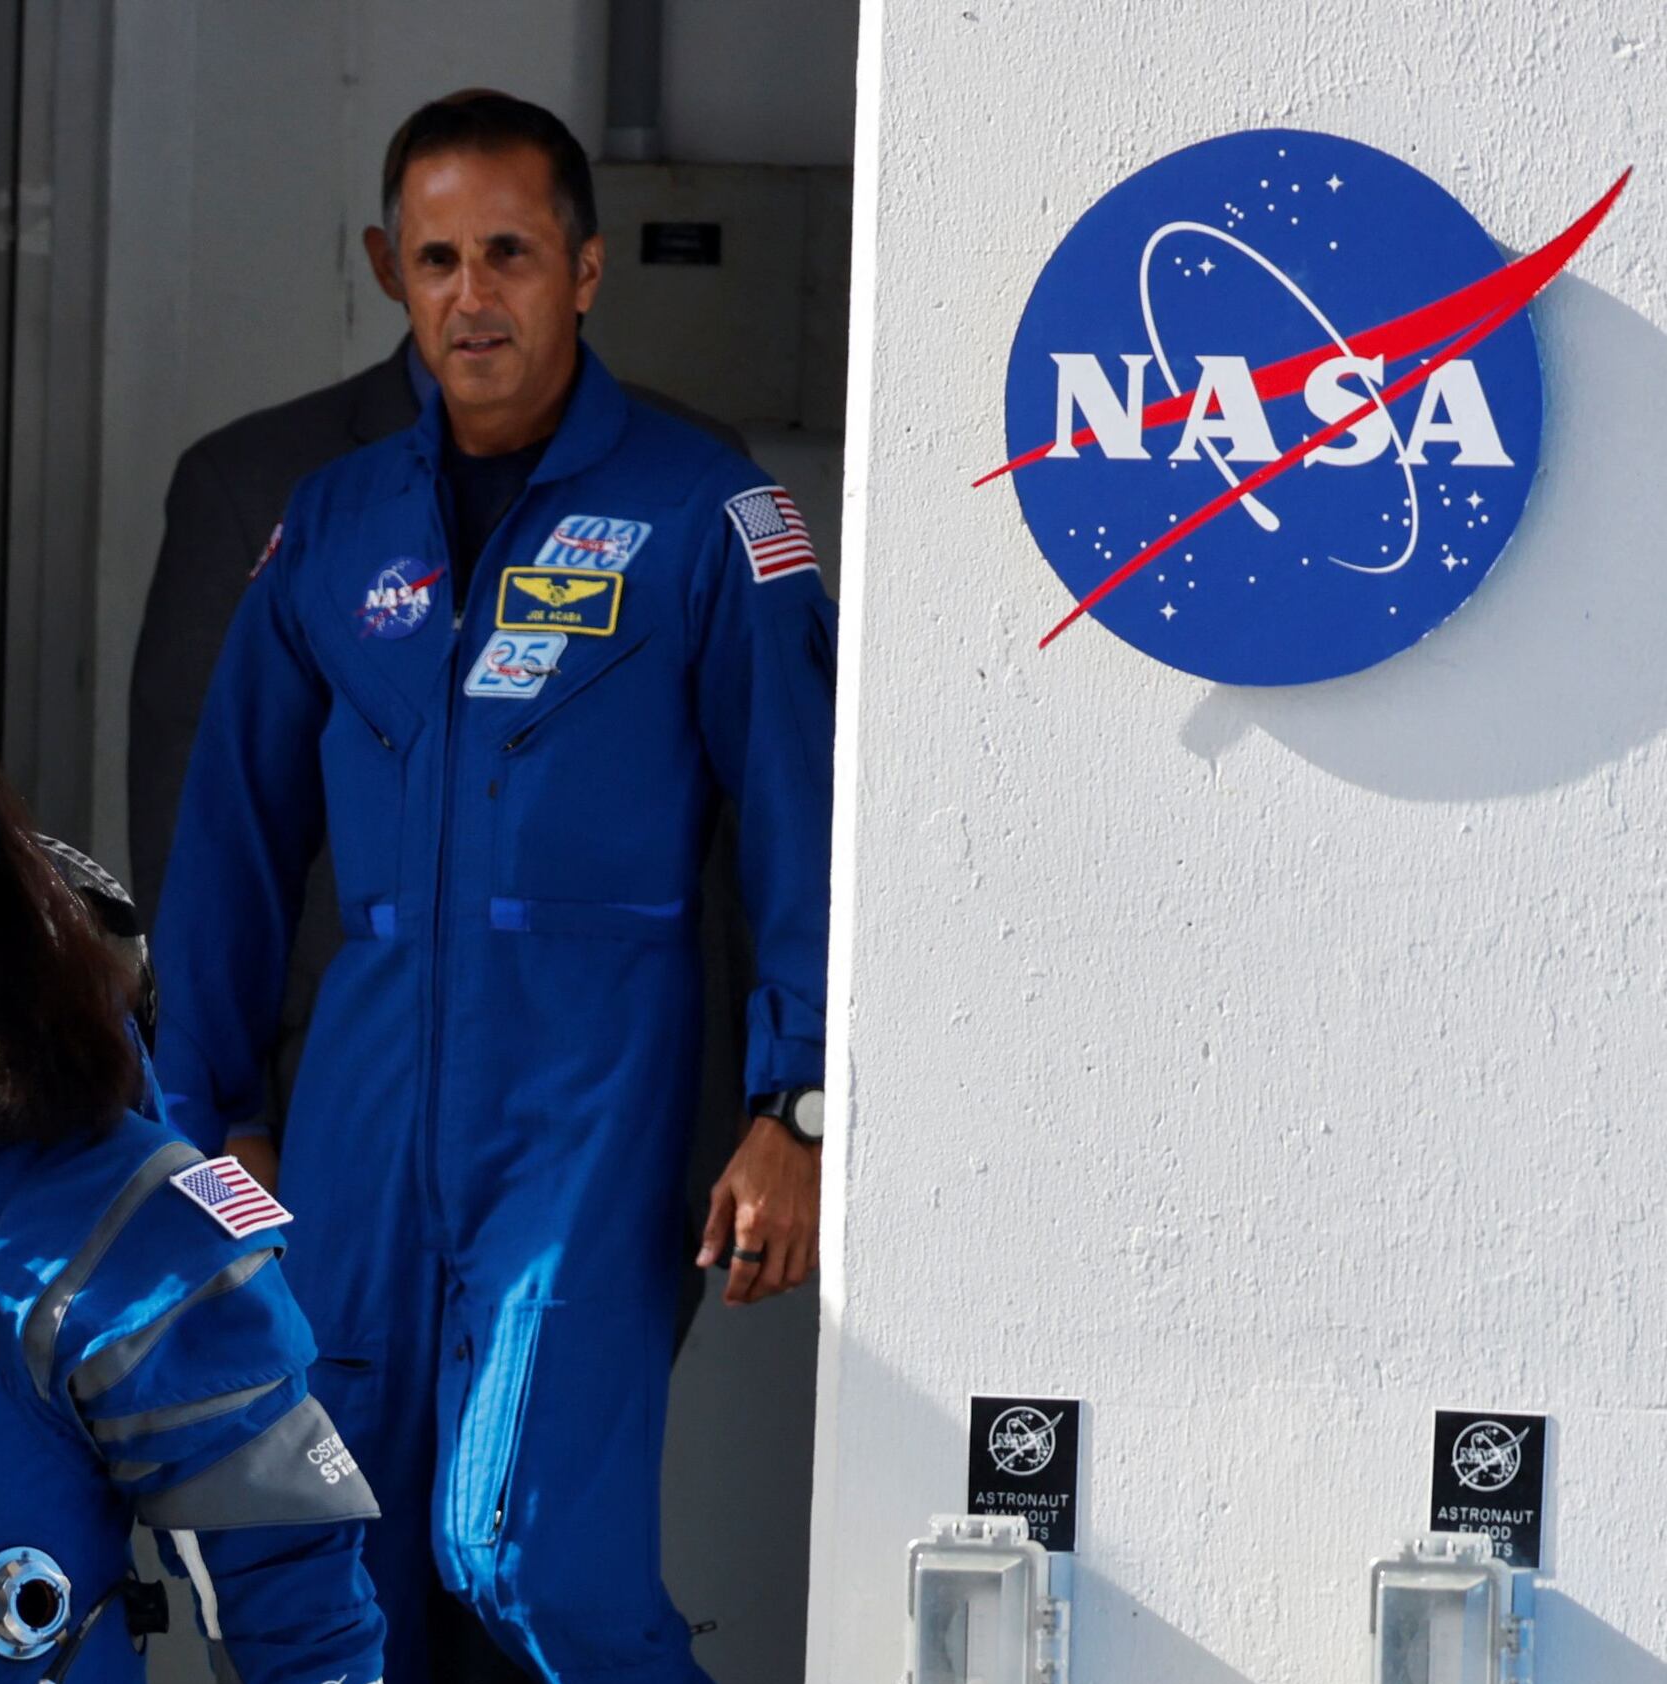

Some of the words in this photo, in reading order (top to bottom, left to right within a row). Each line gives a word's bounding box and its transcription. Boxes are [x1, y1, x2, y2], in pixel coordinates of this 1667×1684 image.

[1046, 352, 1515, 467] NASA
[365, 585, 431, 610] NASA
[526, 610, 545, 622] JOE
[995, 1431, 1051, 1450] NASA
[1459, 1446, 1516, 1466] NASA
[975, 1491, 1069, 1508] ASTRONAUT
[1437, 1505, 1534, 1524] ASTRONAUT
